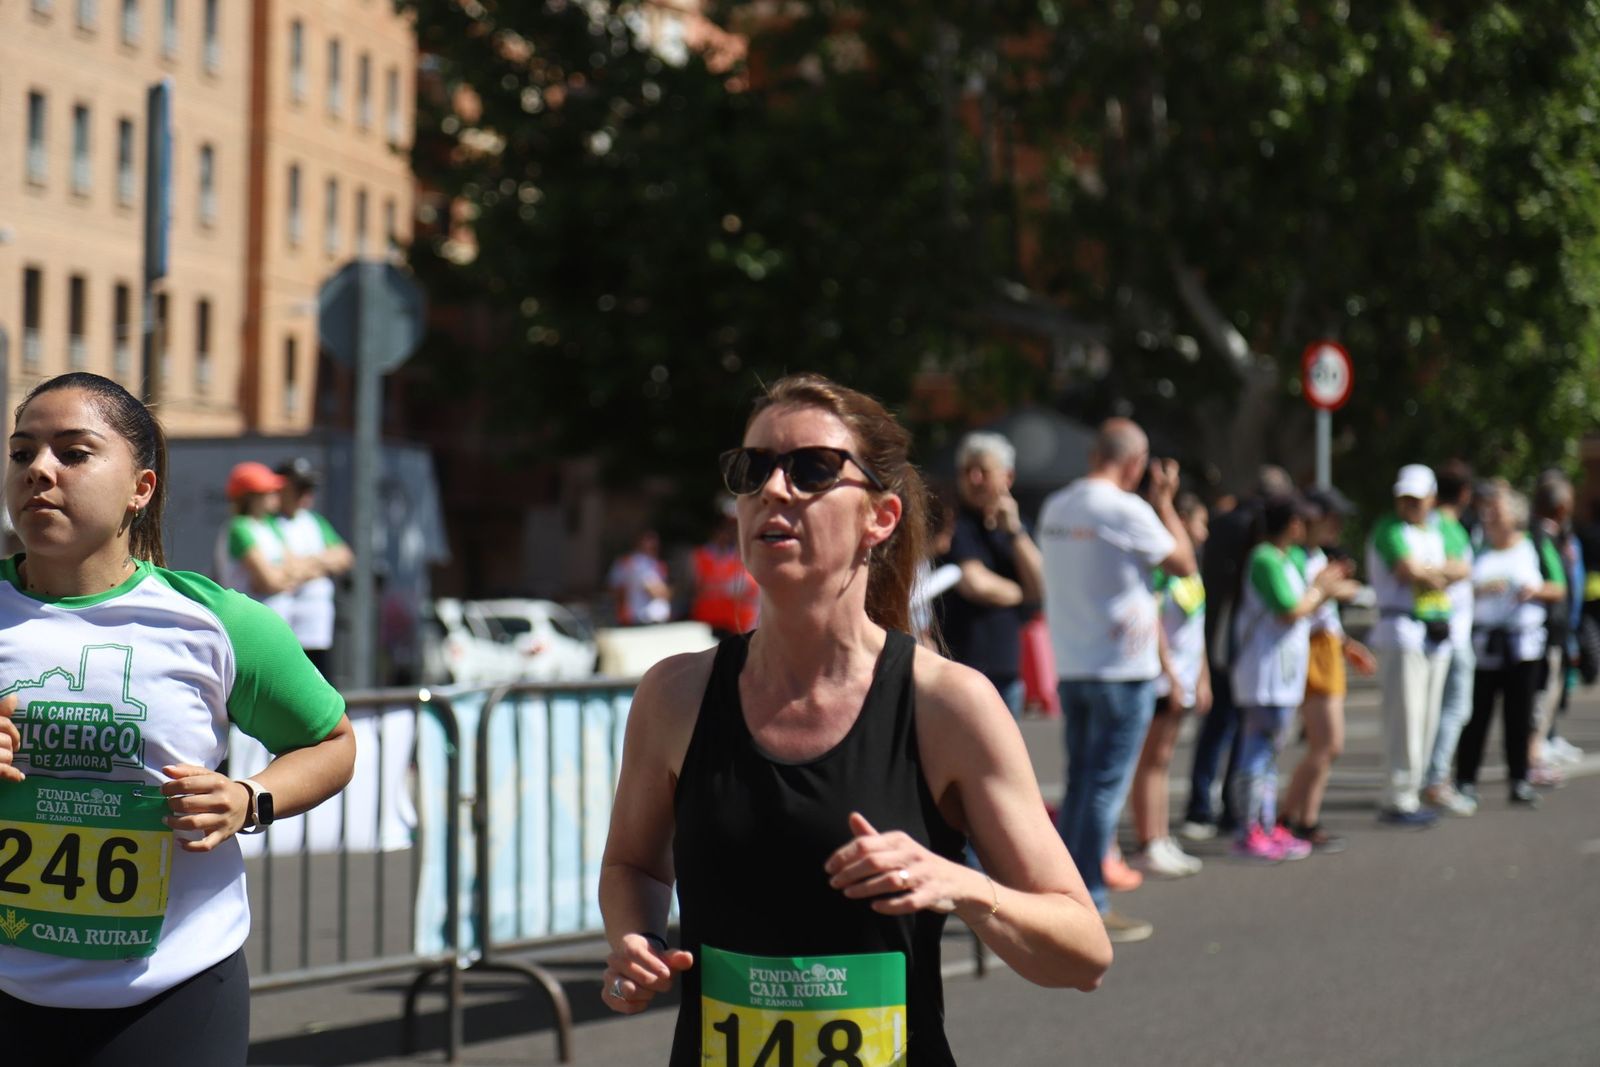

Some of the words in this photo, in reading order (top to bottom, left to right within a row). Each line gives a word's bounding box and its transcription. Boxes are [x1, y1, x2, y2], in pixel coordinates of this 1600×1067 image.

[31, 705, 45, 720] IX
[48, 706, 109, 722] CARRERA
[44, 723, 136, 753] CERCO
[35, 754, 51, 767] DE
[54, 754, 108, 769] ZAMORA
[36, 800, 70, 814] CAJA
[74, 803, 121, 817] RURAL
[49, 814, 82, 823] ZAMORA
[0, 828, 139, 904] 246
[32, 923, 80, 944] CAJA
[84, 929, 152, 946] RURAL
[750, 982, 788, 998] CAJA
[793, 982, 847, 998] RURAL
[765, 998, 804, 1008] ZAMORA
[713, 1013, 864, 1067] 148
